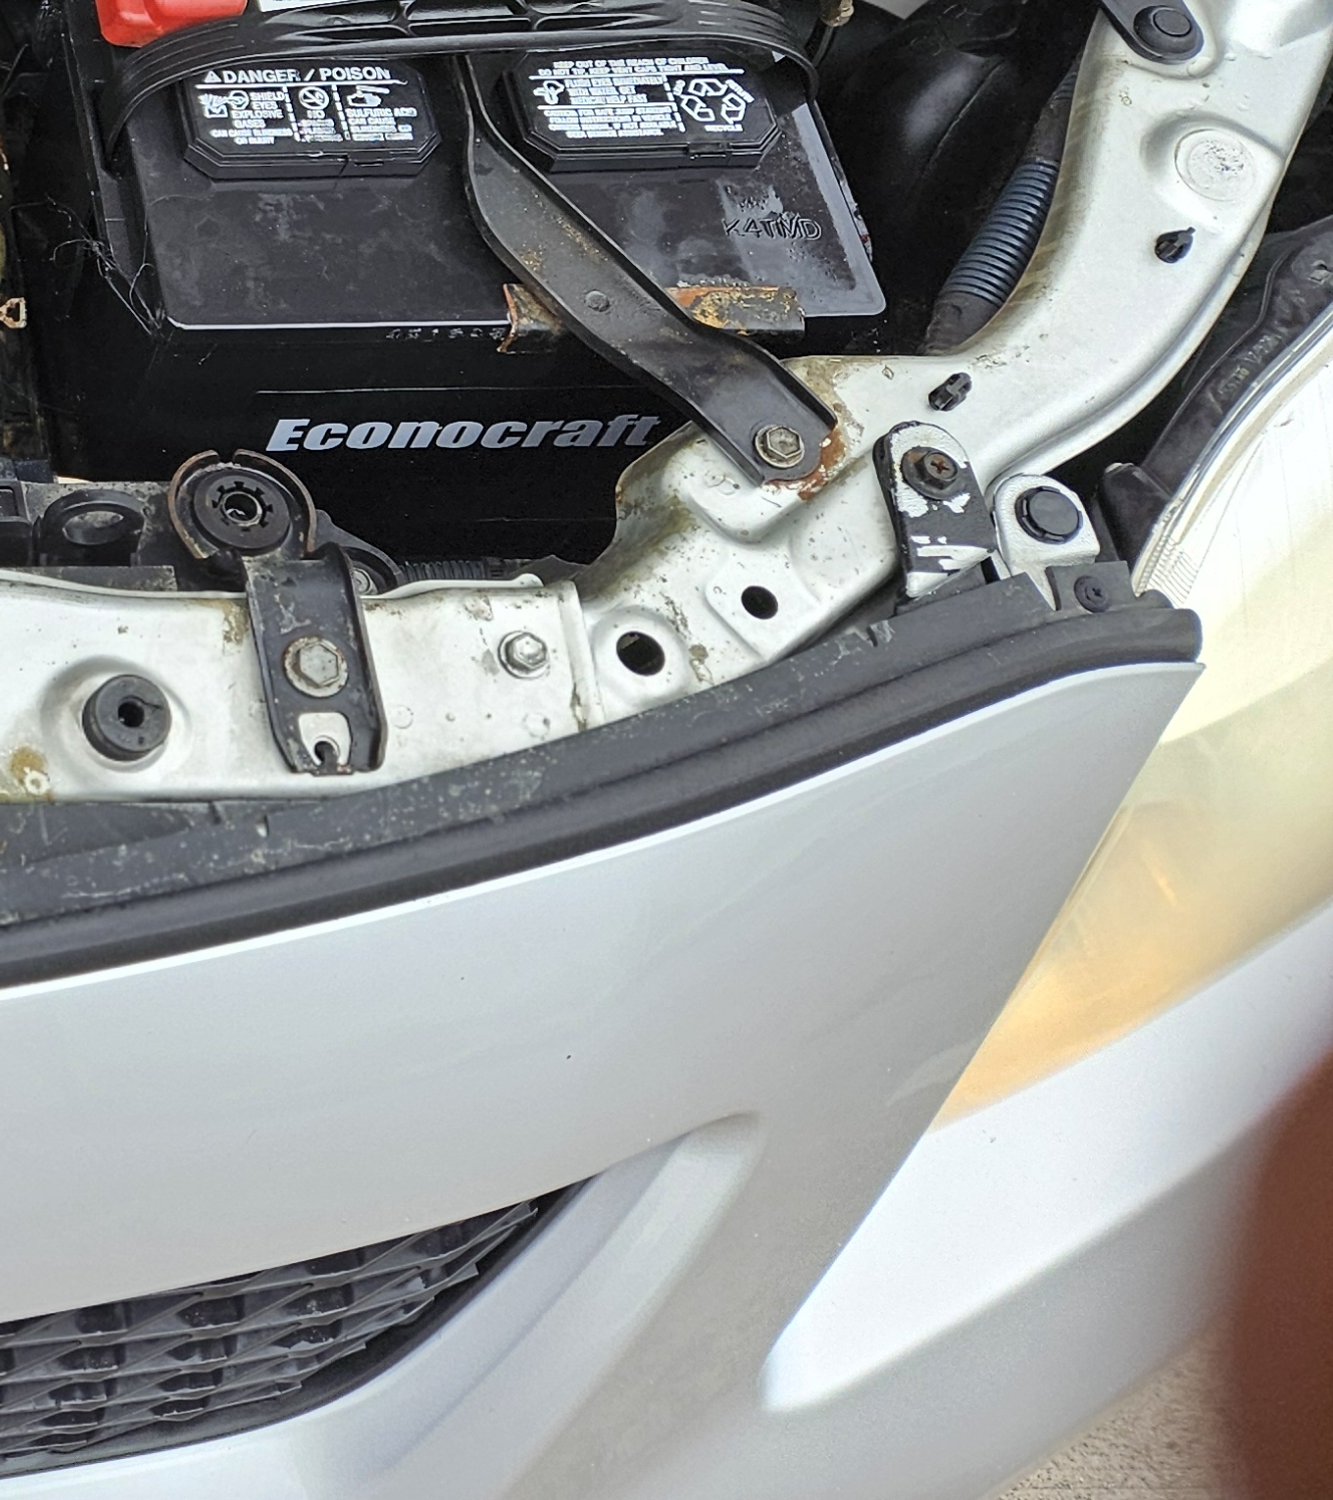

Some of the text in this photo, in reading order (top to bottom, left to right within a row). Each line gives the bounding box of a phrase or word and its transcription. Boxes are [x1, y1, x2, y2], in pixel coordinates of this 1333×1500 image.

[223, 69, 300, 83] DANGER
[319, 67, 391, 81] POISON
[250, 91, 285, 100] SHIELD
[251, 101, 278, 110] EYES
[231, 109, 284, 119] EXPLOSIVE
[394, 107, 417, 117] ACID
[234, 119, 266, 128] GASES
[265, 414, 661, 452] Econocraft
